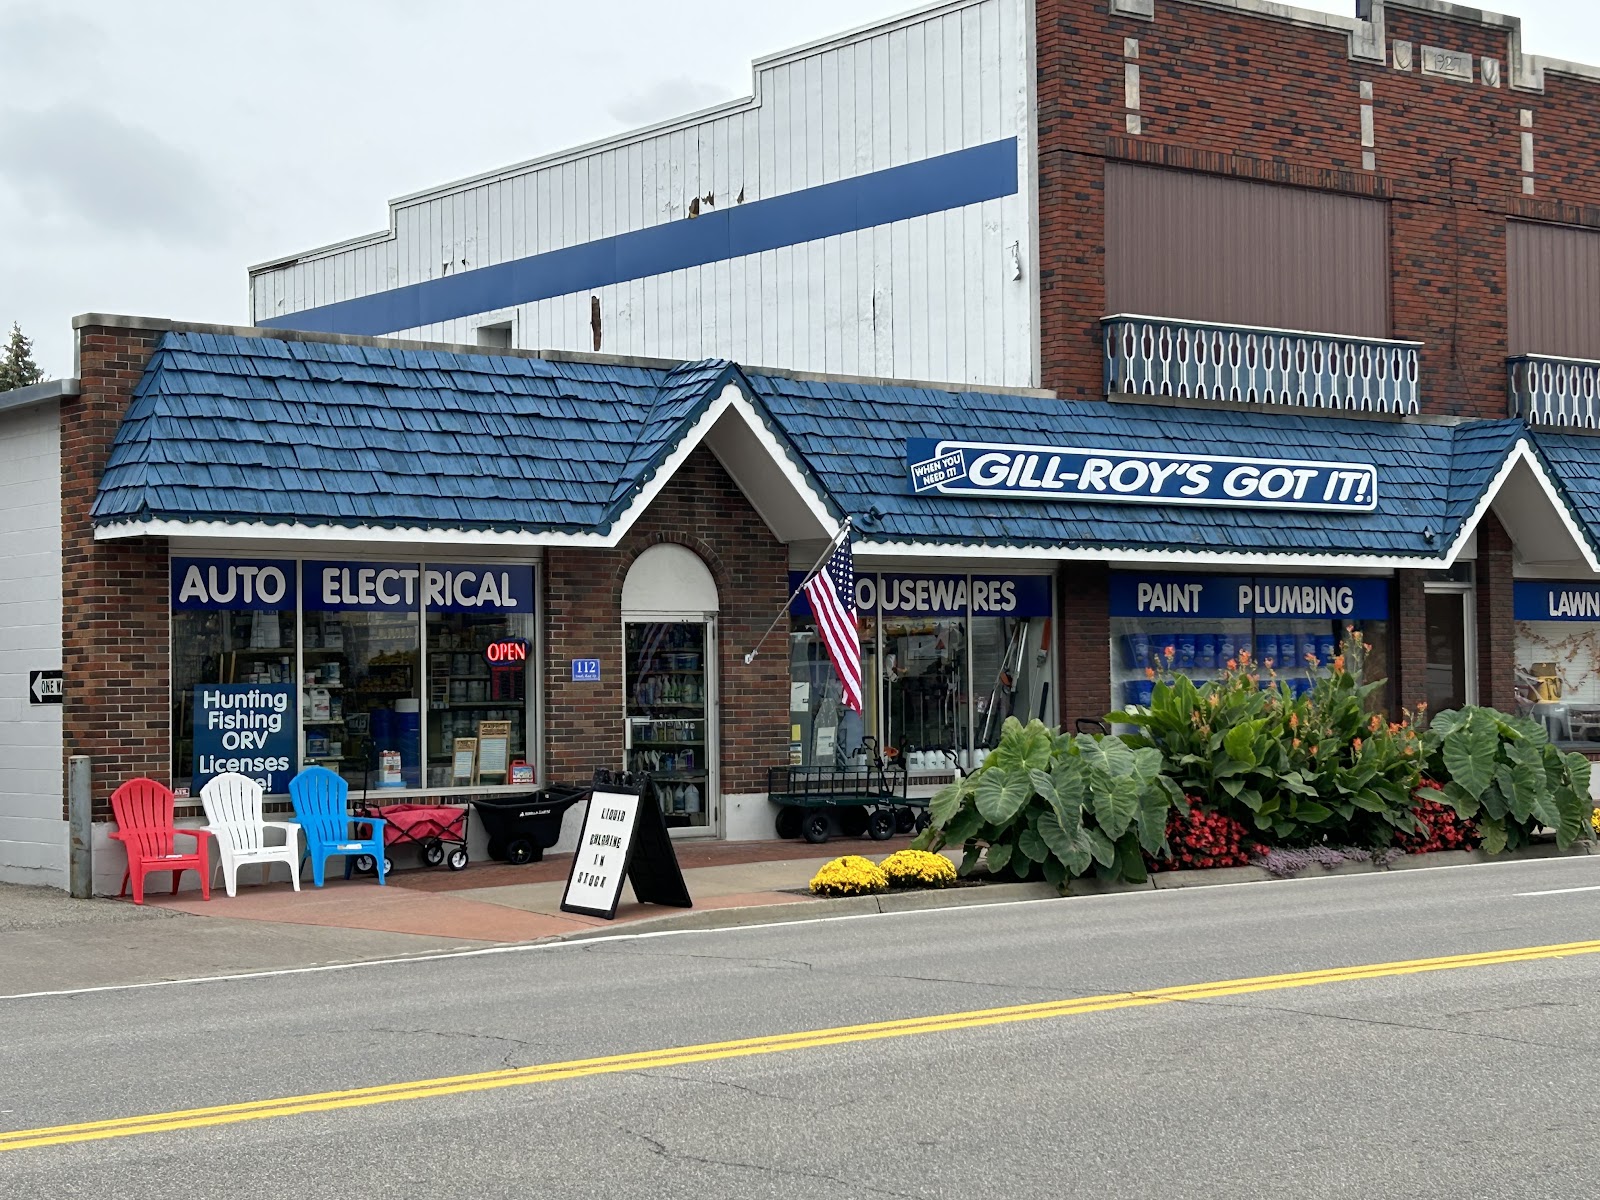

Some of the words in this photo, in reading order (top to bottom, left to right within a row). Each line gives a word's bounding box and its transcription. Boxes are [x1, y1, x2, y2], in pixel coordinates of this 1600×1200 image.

[914, 461, 942, 477] WHEN
[942, 455, 961, 467] YOU
[922, 471, 945, 485] NEED
[968, 452, 1213, 495] GILL-ROY'S
[1222, 466, 1319, 500] GOT
[1323, 470, 1371, 503] IT!
[178, 564, 287, 604] AUTO
[322, 567, 518, 607] ELECTRICAL
[855, 578, 1017, 612] OUSEWARES
[1137, 582, 1203, 613] PAINT
[1238, 585, 1354, 615] PLUMBING
[1549, 591, 1600, 617] LAWN
[487, 642, 526, 662] OPEN
[577, 661, 596, 673] 112
[41, 680, 55, 694] ONE
[203, 689, 288, 713] Hunting
[208, 709, 282, 733] Fishing
[221, 730, 268, 750] ORV
[199, 755, 289, 774] Licenses
[601, 807, 626, 822] LIQUID
[589, 833, 622, 849] CHLORINE
[593, 853, 606, 867] IN
[577, 871, 607, 888] STOCK
